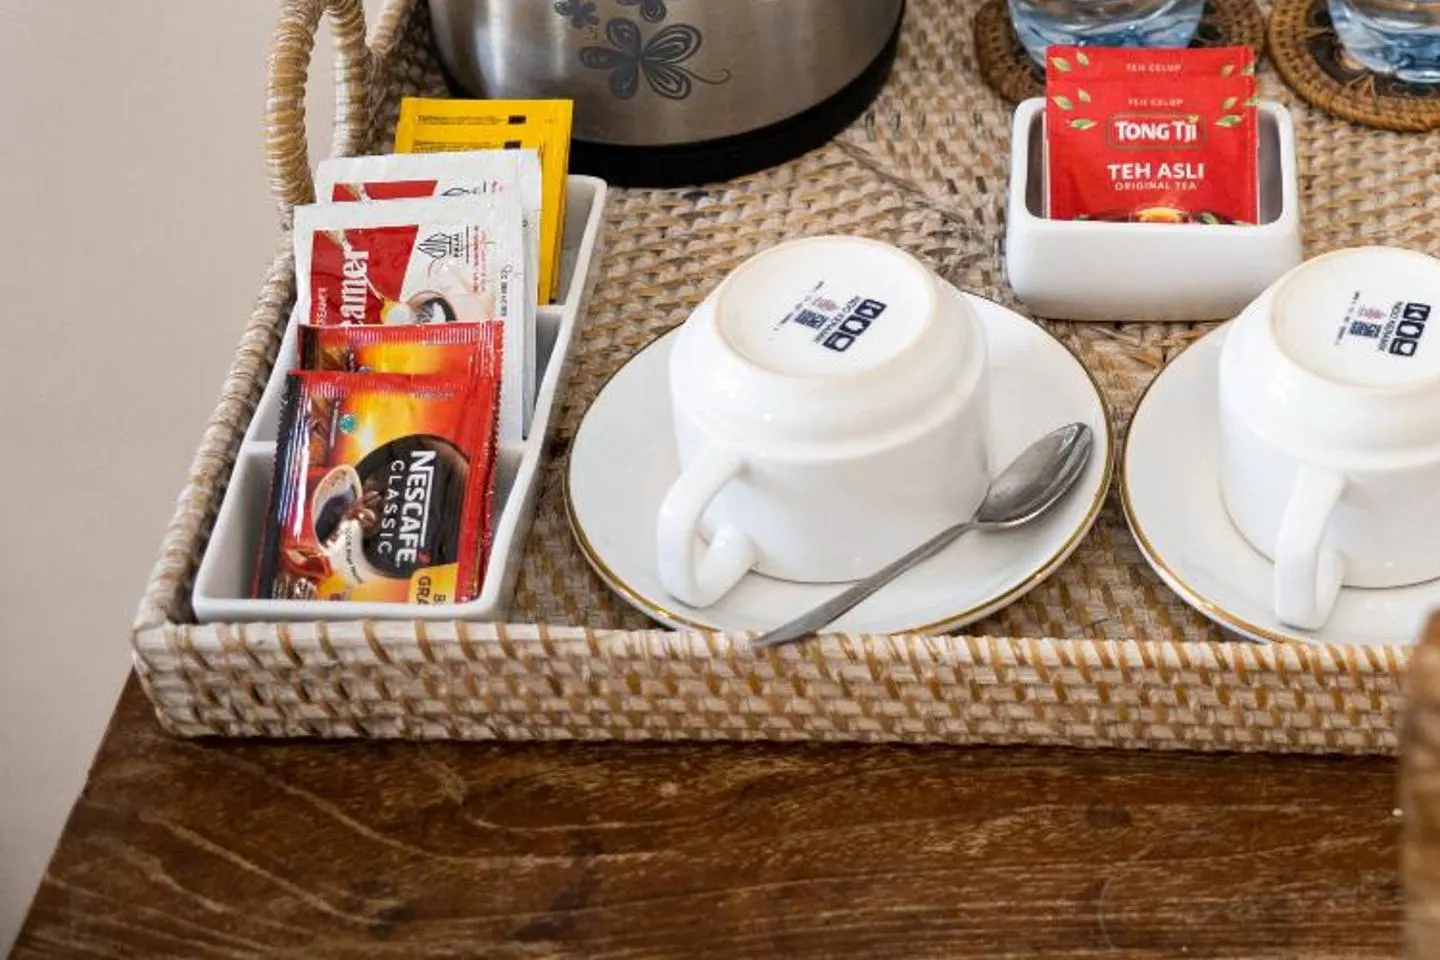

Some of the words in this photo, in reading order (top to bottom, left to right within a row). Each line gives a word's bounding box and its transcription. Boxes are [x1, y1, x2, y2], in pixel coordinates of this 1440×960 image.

[1114, 121, 1170, 142] TONG
[1107, 163, 1151, 180] TEH
[1157, 162, 1205, 180] ASLI
[1114, 181, 1171, 191] ORIGINAL
[1175, 181, 1198, 191] TEA
[377, 460, 405, 555] CLASSIC
